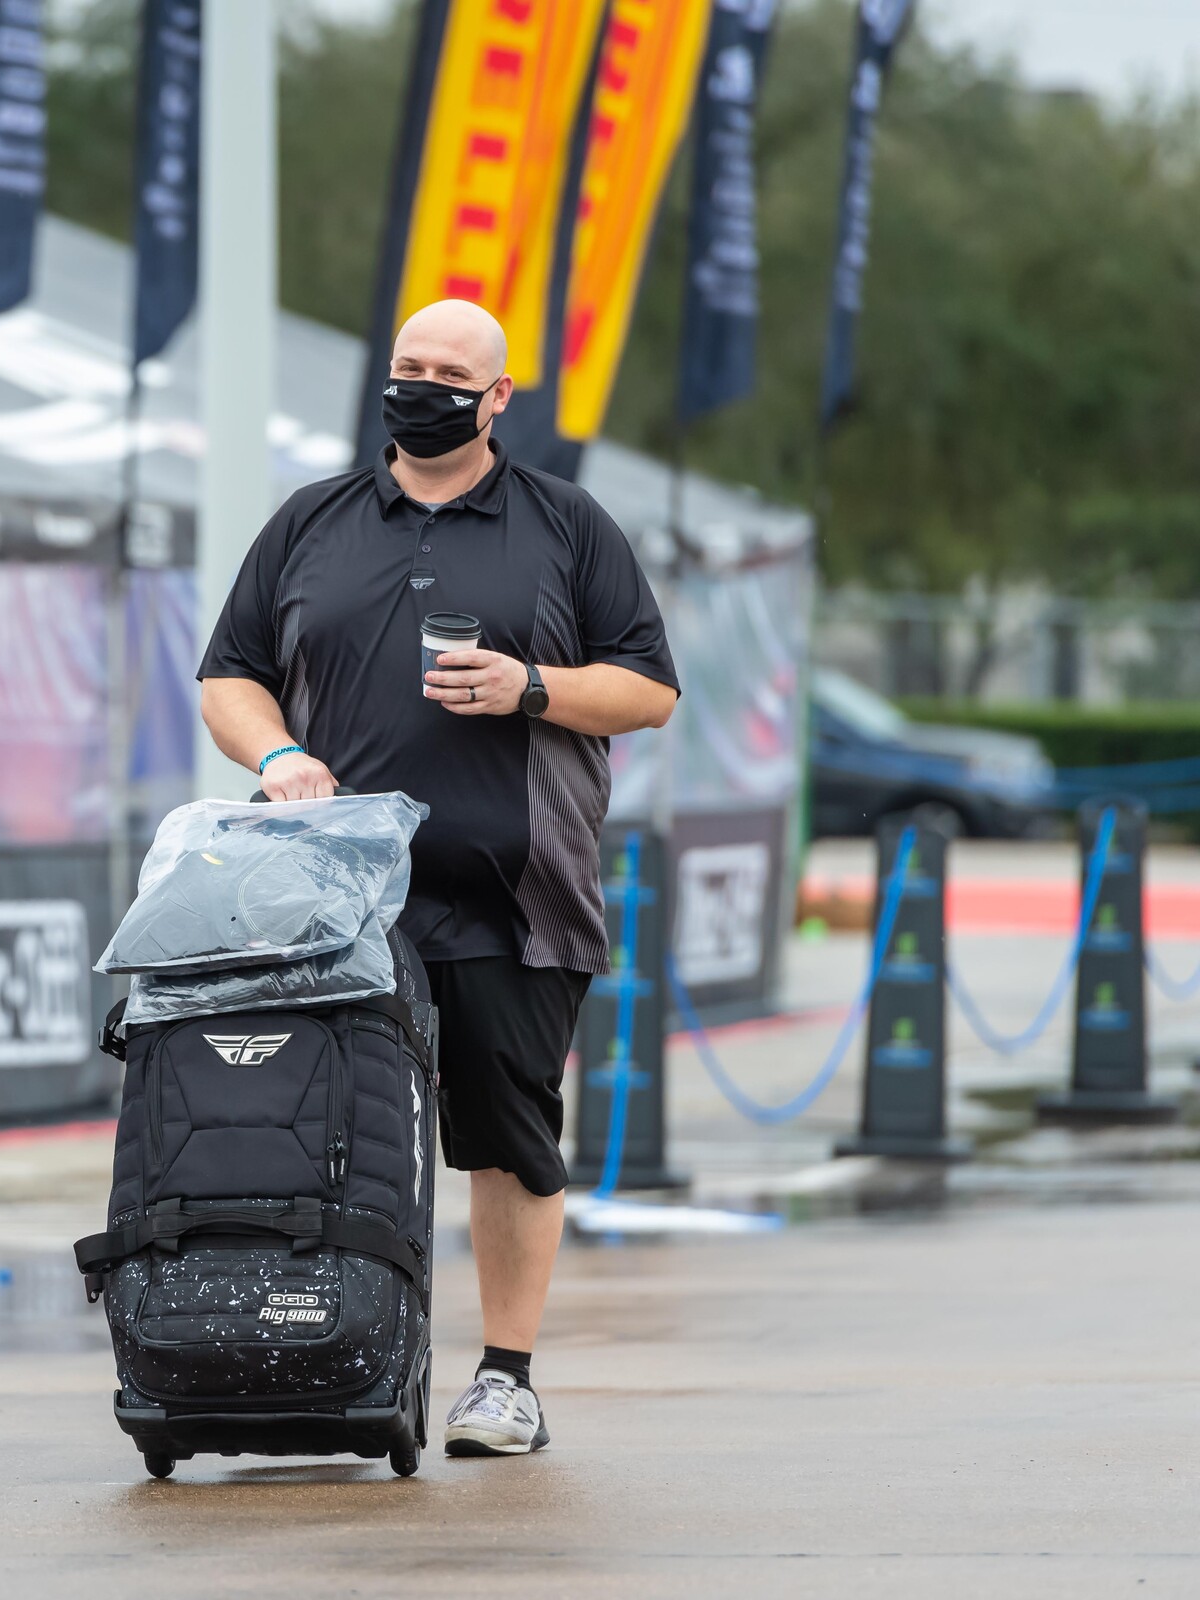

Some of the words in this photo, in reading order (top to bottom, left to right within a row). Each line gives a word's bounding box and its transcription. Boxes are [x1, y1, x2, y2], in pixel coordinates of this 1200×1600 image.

[265, 746, 296, 762] ROUND
[268, 1294, 319, 1306] OGIO
[259, 1307, 286, 1324] Rig
[286, 1309, 327, 1323] 9800
